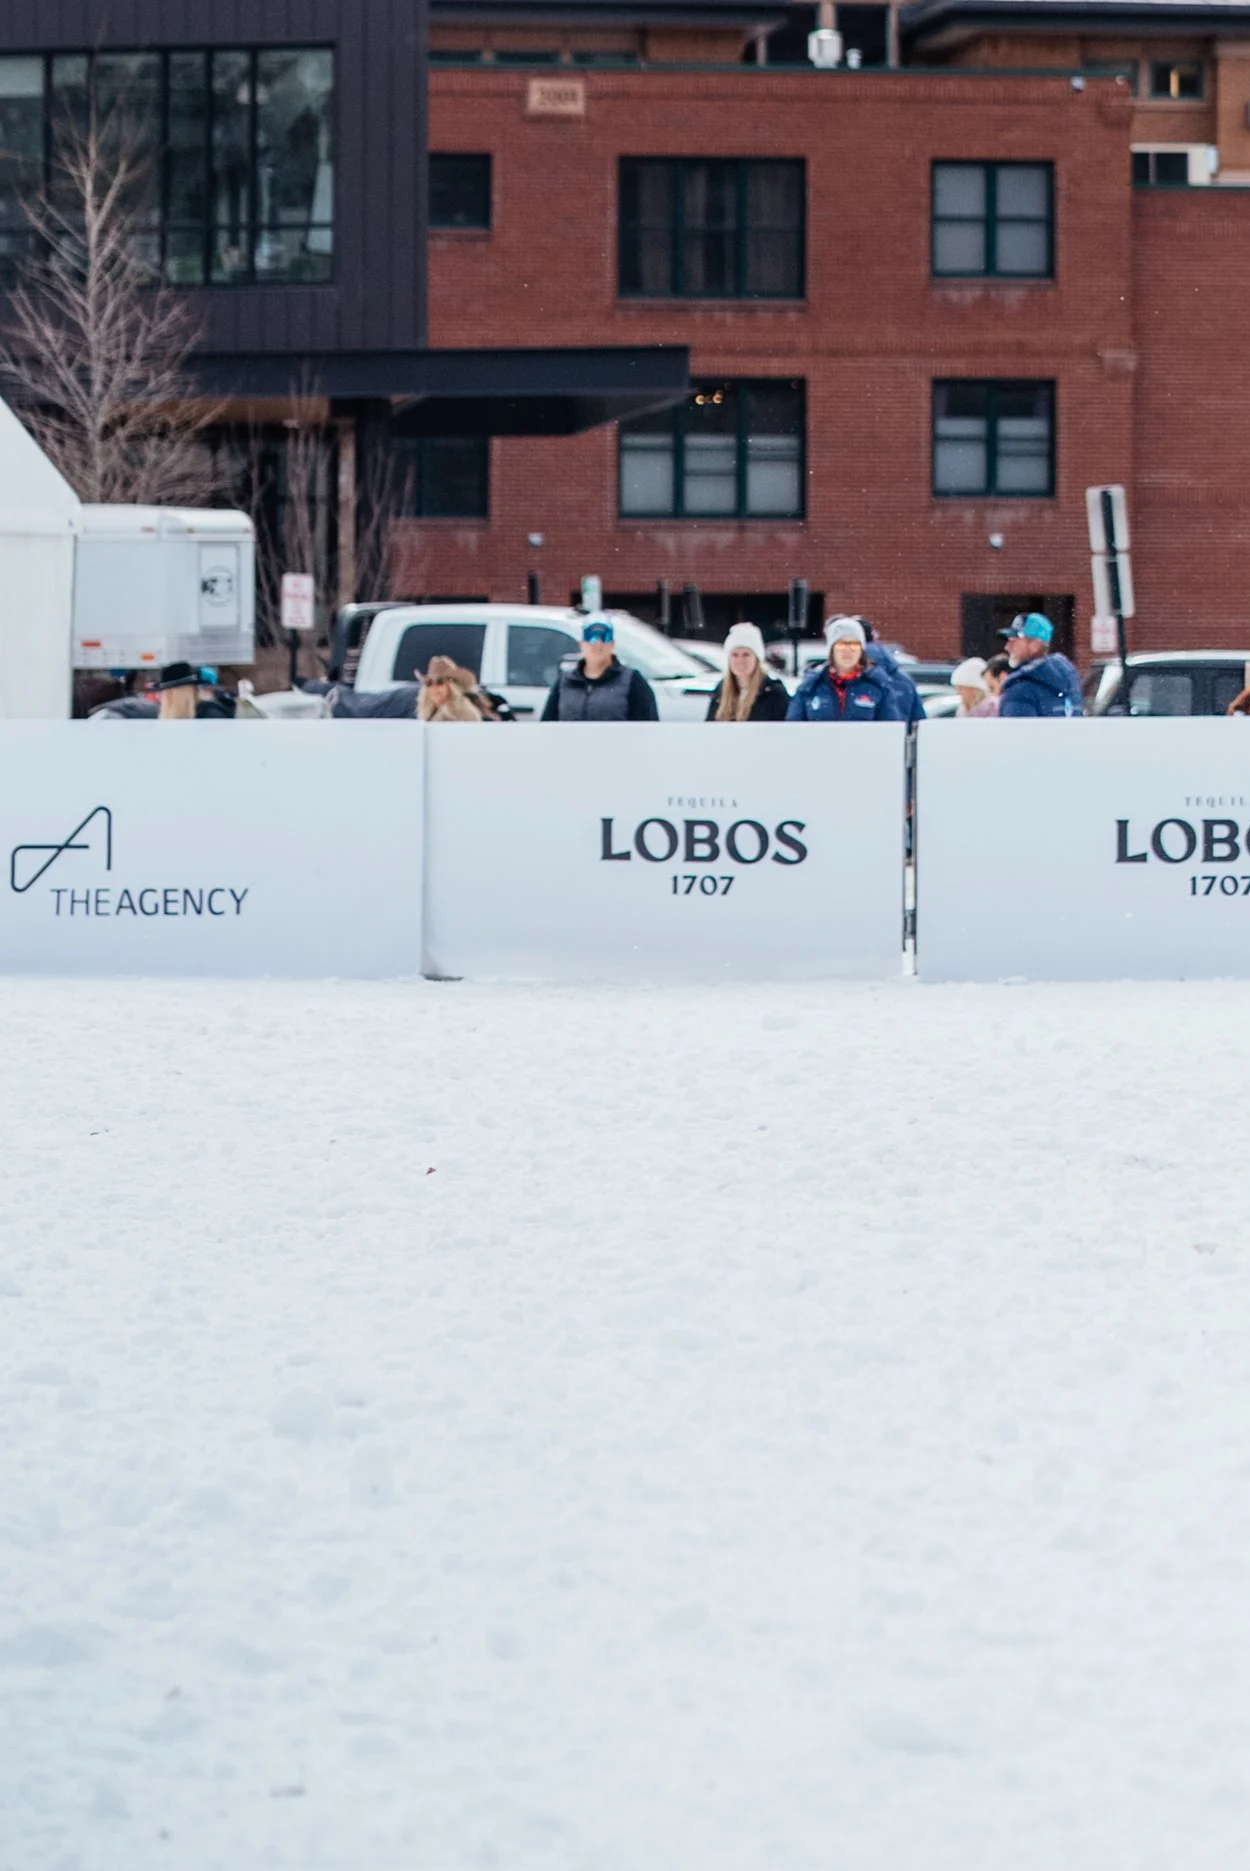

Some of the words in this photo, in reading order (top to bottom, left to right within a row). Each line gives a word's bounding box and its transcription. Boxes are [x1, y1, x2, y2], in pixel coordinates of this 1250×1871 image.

[667, 796, 738, 809] TEQUILA
[600, 817, 808, 865] LOBOS
[671, 875, 735, 896] 1707
